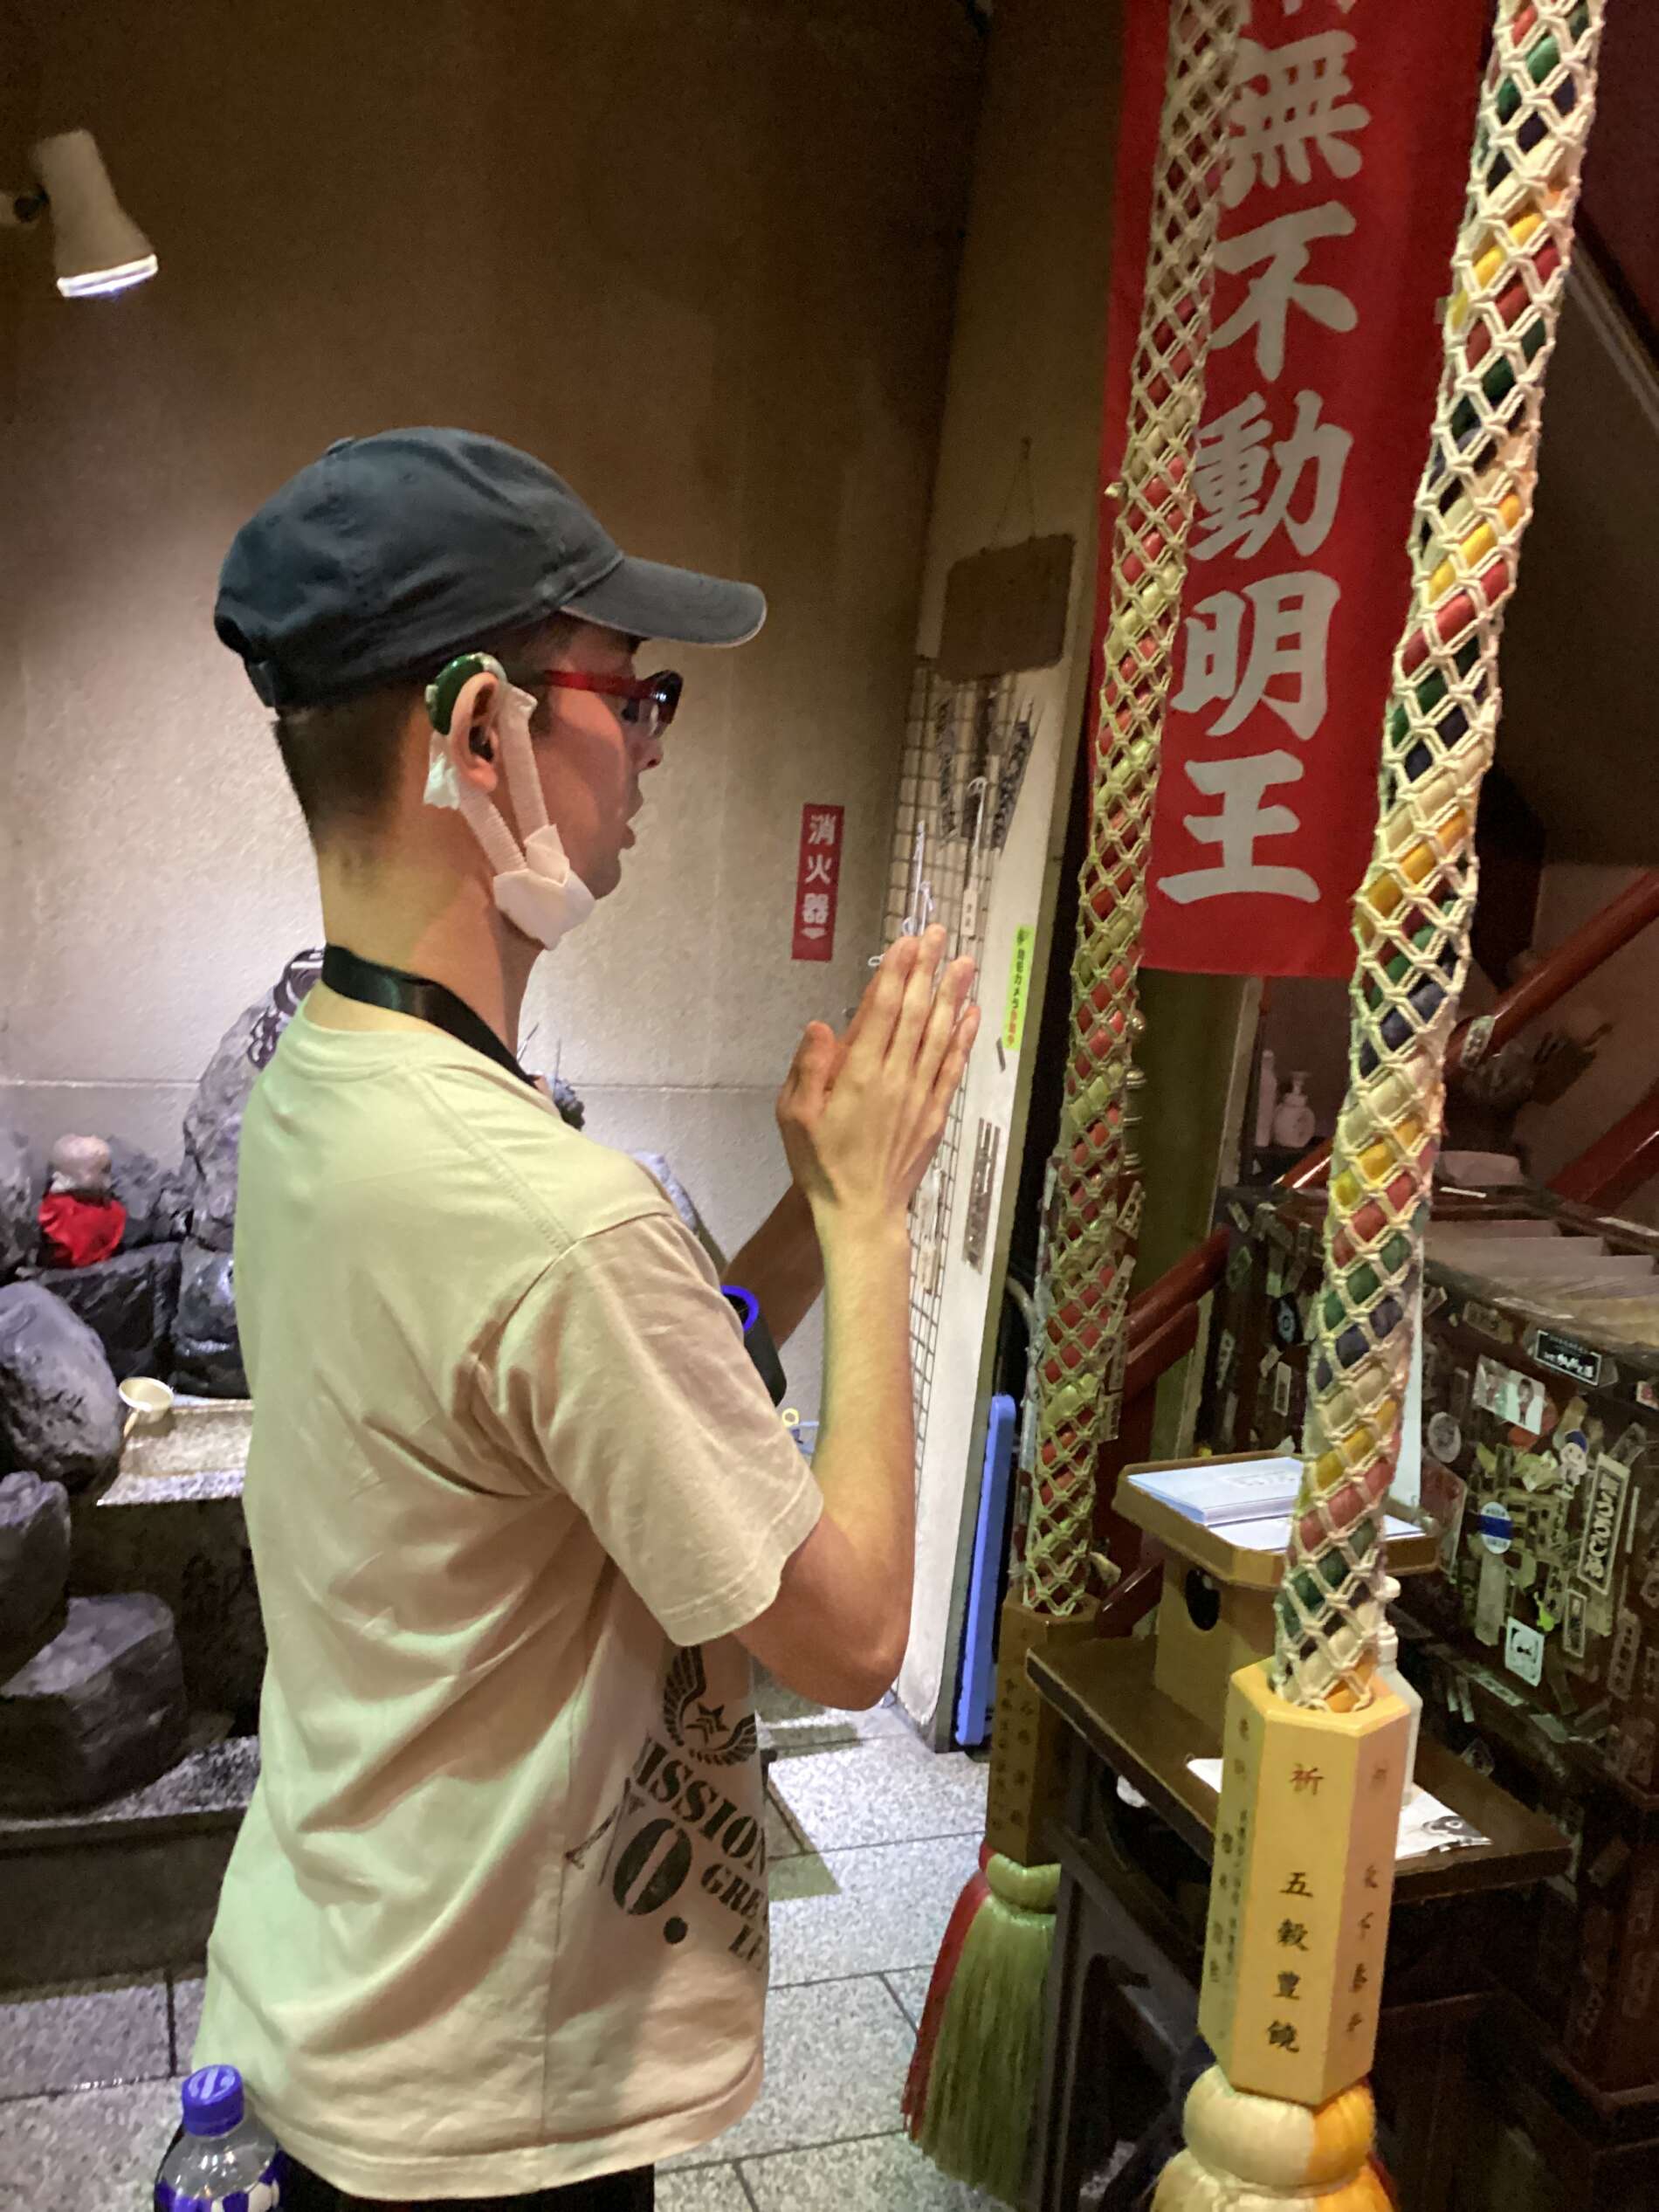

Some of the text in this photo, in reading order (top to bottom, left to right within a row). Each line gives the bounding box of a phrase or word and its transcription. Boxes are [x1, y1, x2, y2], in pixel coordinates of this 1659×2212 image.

[1158, 0, 1372, 906] 無不動明王
[802, 814, 836, 924] 消火器
[635, 1733, 767, 1875] ISSION
